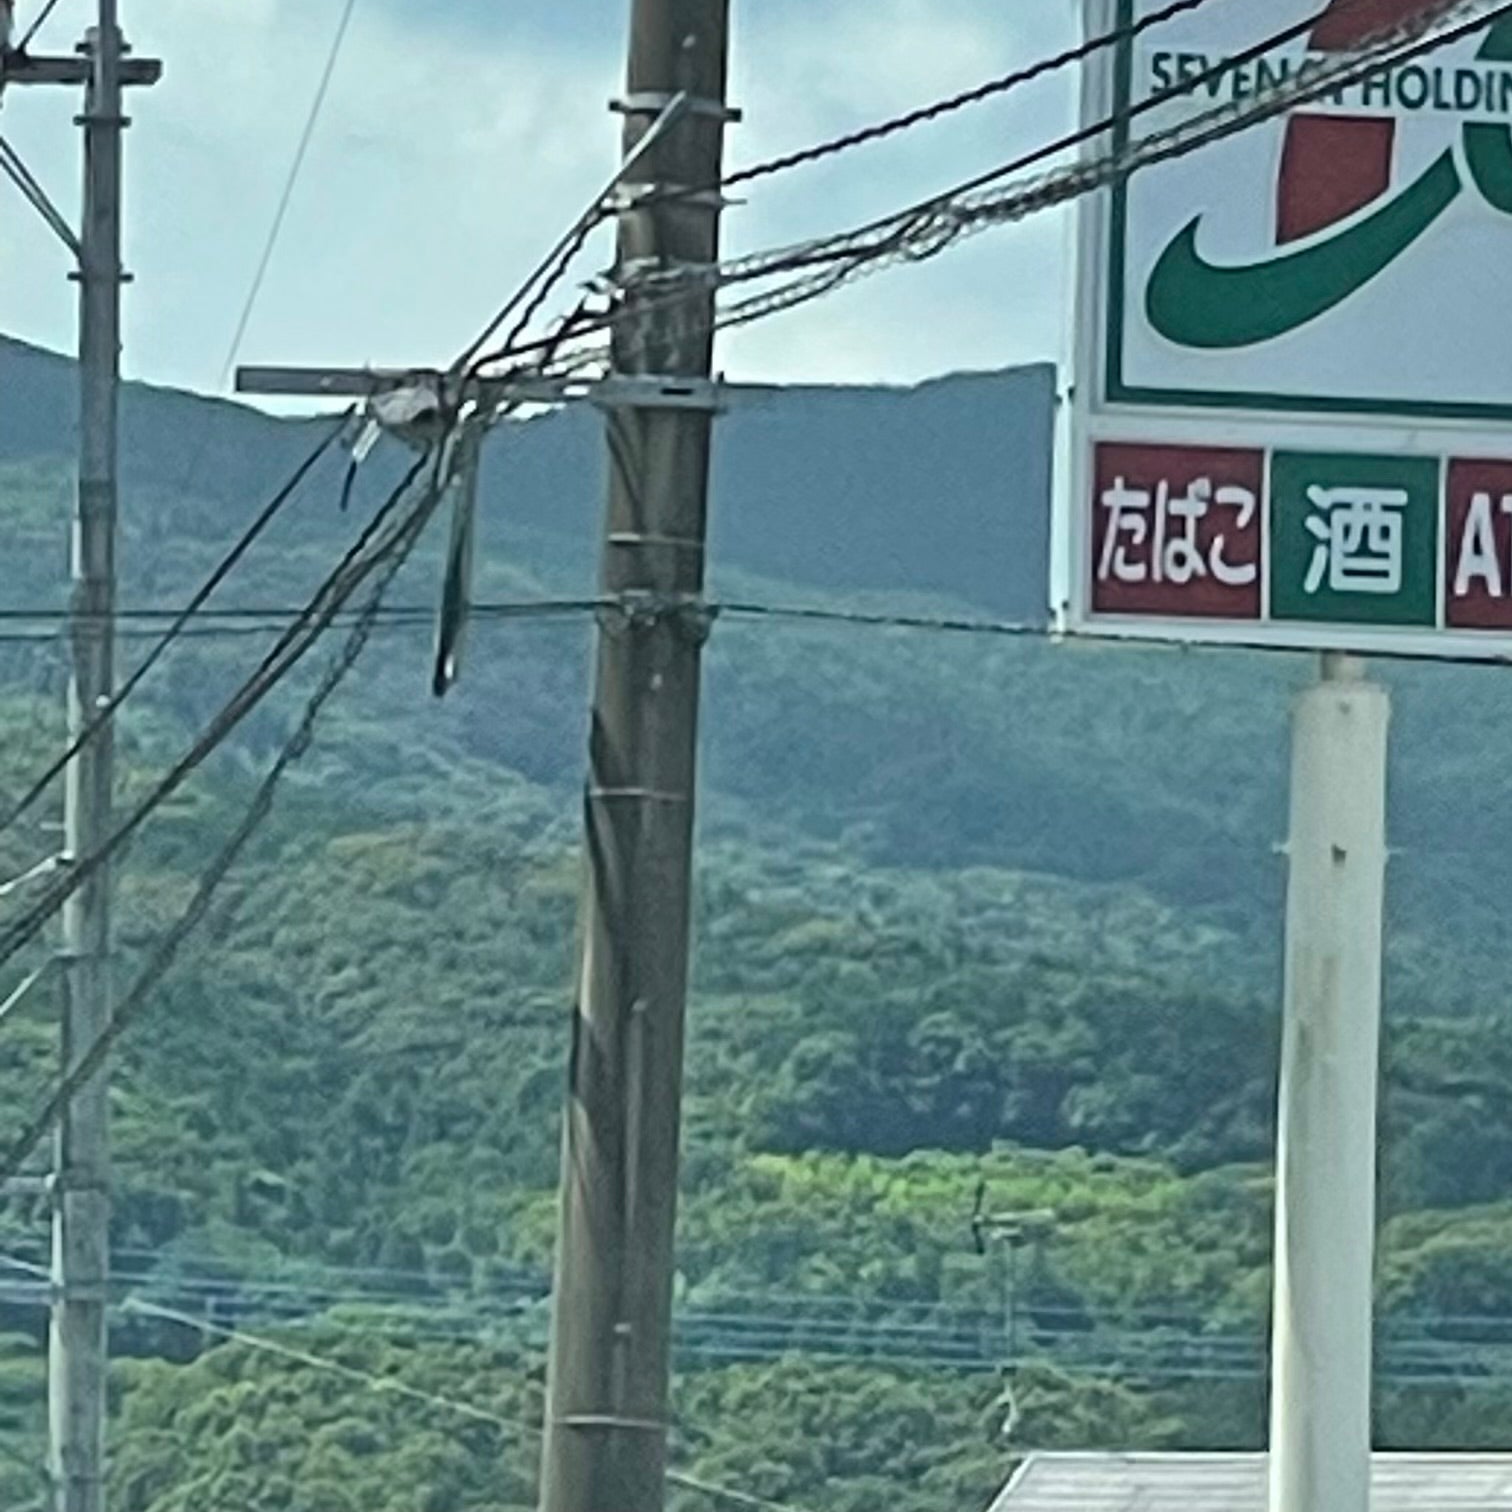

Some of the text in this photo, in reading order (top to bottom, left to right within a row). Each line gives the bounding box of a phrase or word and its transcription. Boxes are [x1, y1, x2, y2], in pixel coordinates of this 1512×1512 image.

[1098, 476, 1256, 585] たばこ
[1304, 484, 1408, 594] 酒
